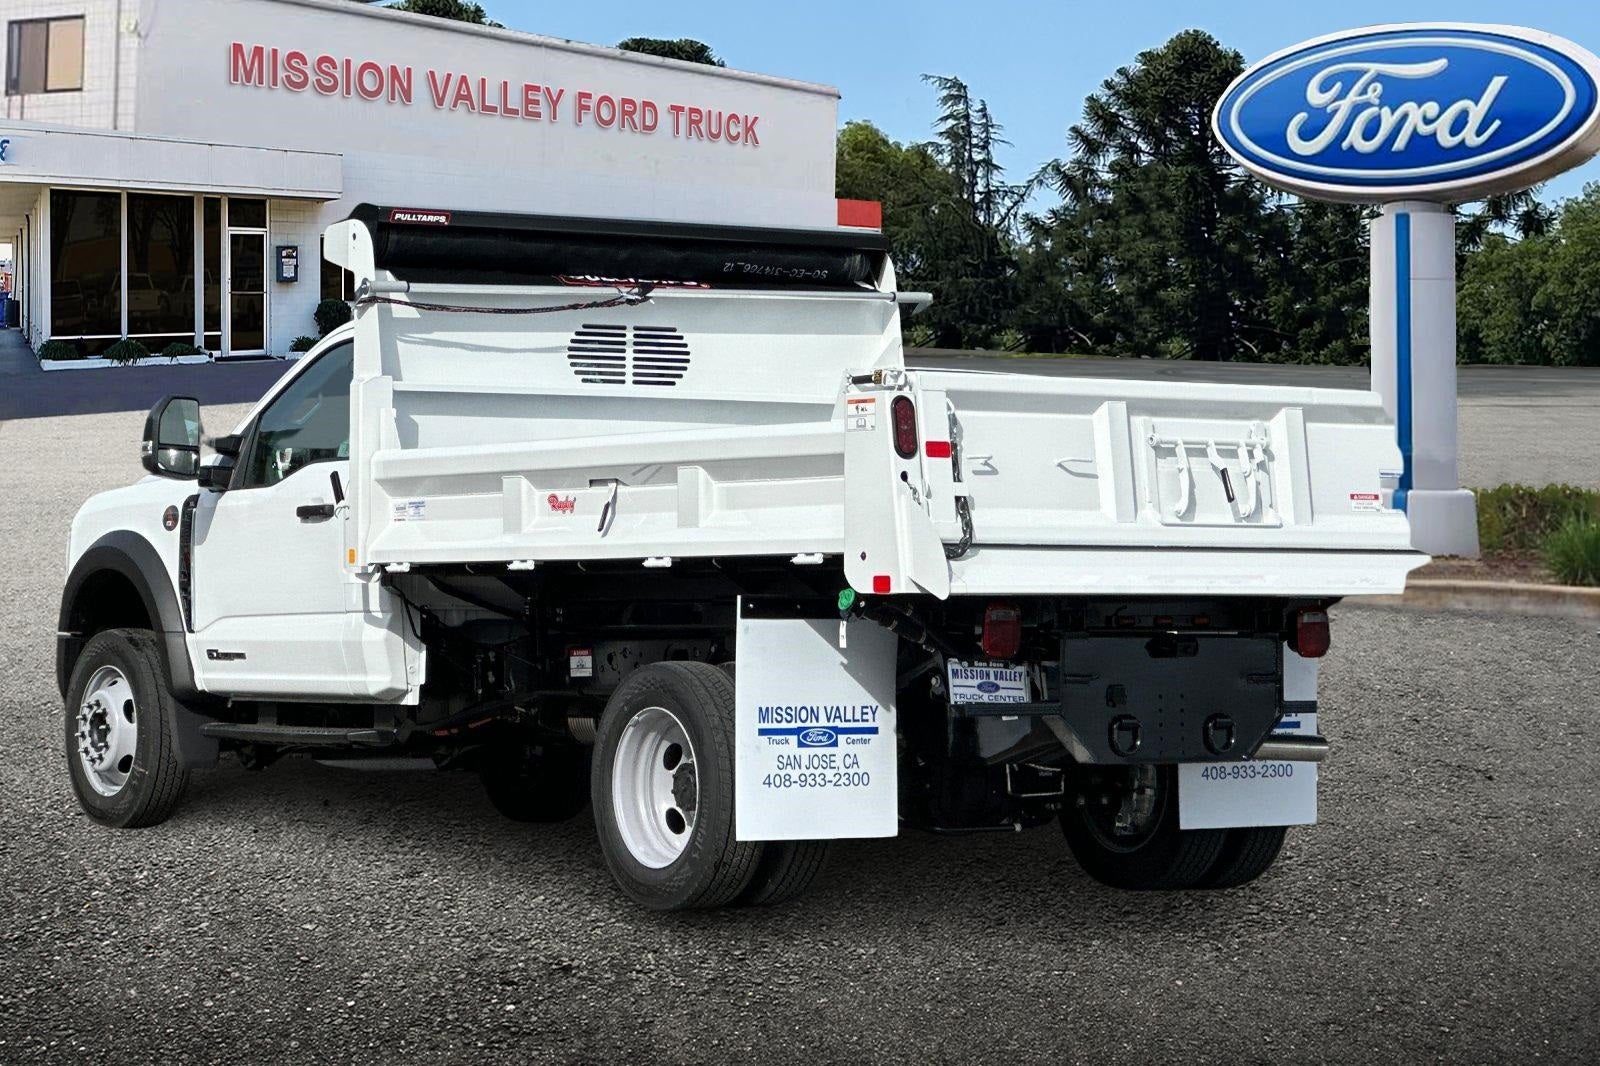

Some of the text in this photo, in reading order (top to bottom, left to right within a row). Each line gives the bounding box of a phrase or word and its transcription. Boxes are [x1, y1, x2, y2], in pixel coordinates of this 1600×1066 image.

[229, 41, 760, 146] MISSION VALLEY FORD TRUCK
[1286, 57, 1509, 156] Ford
[395, 213, 447, 224] PULLTARPS
[951, 668, 1024, 682] MISSION VALLEY
[953, 693, 1025, 703] TRUCK CENTER
[758, 705, 879, 724] MISSION VALLEY
[767, 736, 790, 746] Truck
[845, 736, 872, 746] Center
[776, 753, 860, 772] SAN JOSE, CA
[762, 771, 870, 788] 408-933-2300
[1201, 763, 1293, 780] 408-933-2300
